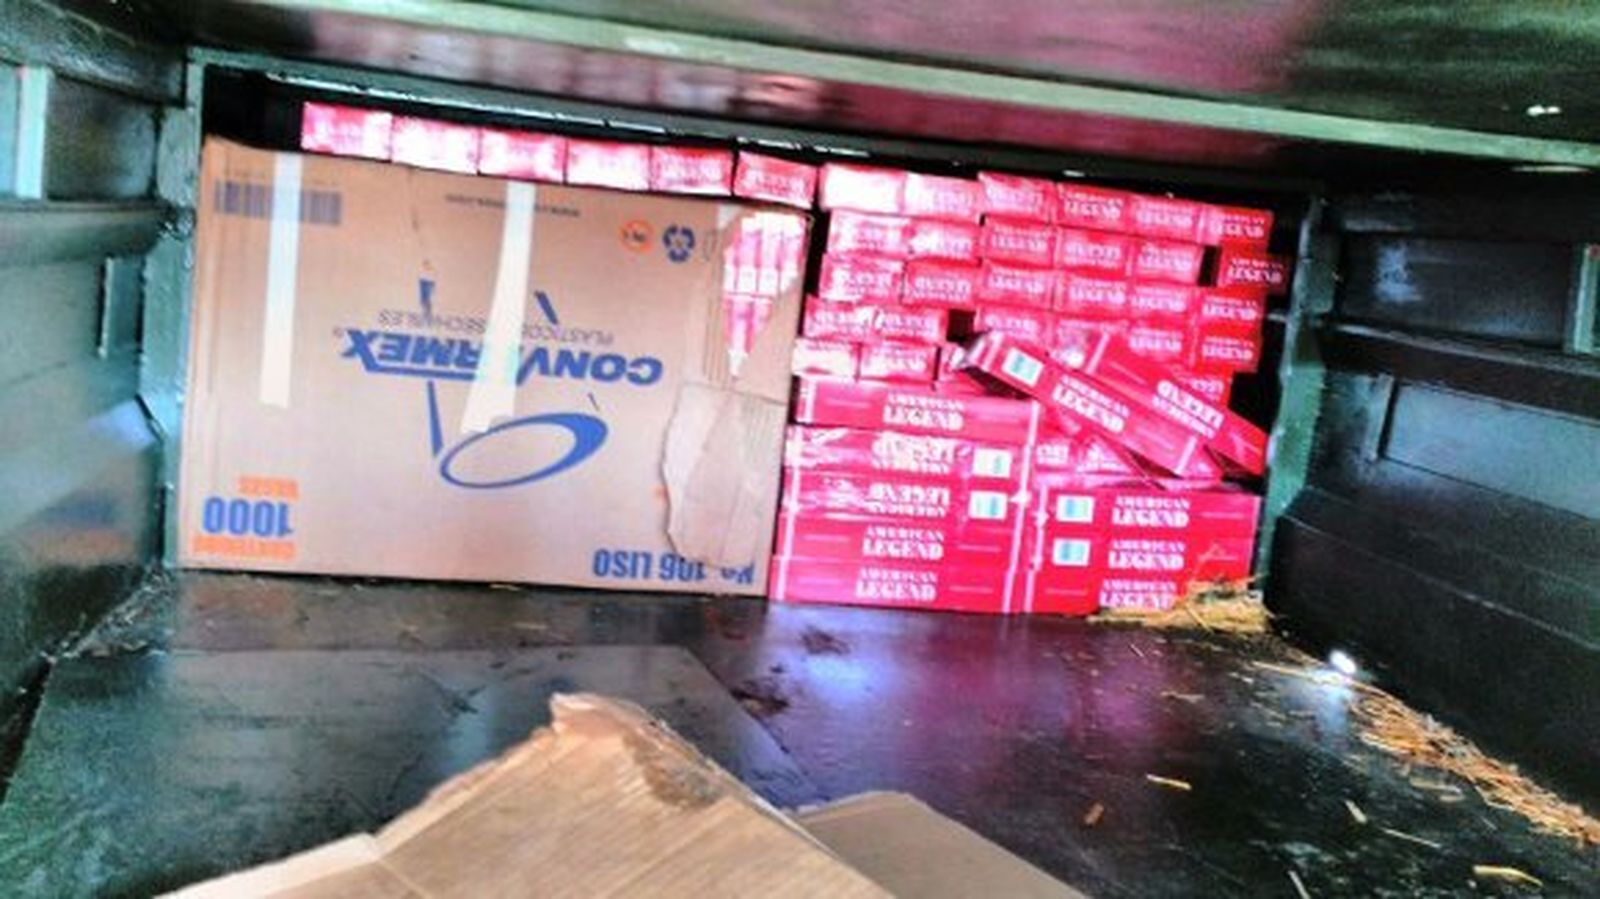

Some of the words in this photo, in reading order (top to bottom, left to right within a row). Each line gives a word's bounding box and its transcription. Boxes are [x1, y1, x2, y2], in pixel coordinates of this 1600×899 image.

[340, 329, 664, 386] CONVRMEX
[882, 405, 964, 431] LEGEND
[1052, 384, 1126, 433] LEGEND
[1157, 380, 1224, 430] LEGEND
[868, 485, 951, 506] LEGEND
[203, 496, 294, 539] 1000
[1112, 508, 1190, 528] LEGEND
[862, 537, 945, 560] LEGEND
[1108, 551, 1185, 571] LEGEND
[592, 549, 654, 579] LISO
[855, 580, 938, 602] LEGEND
